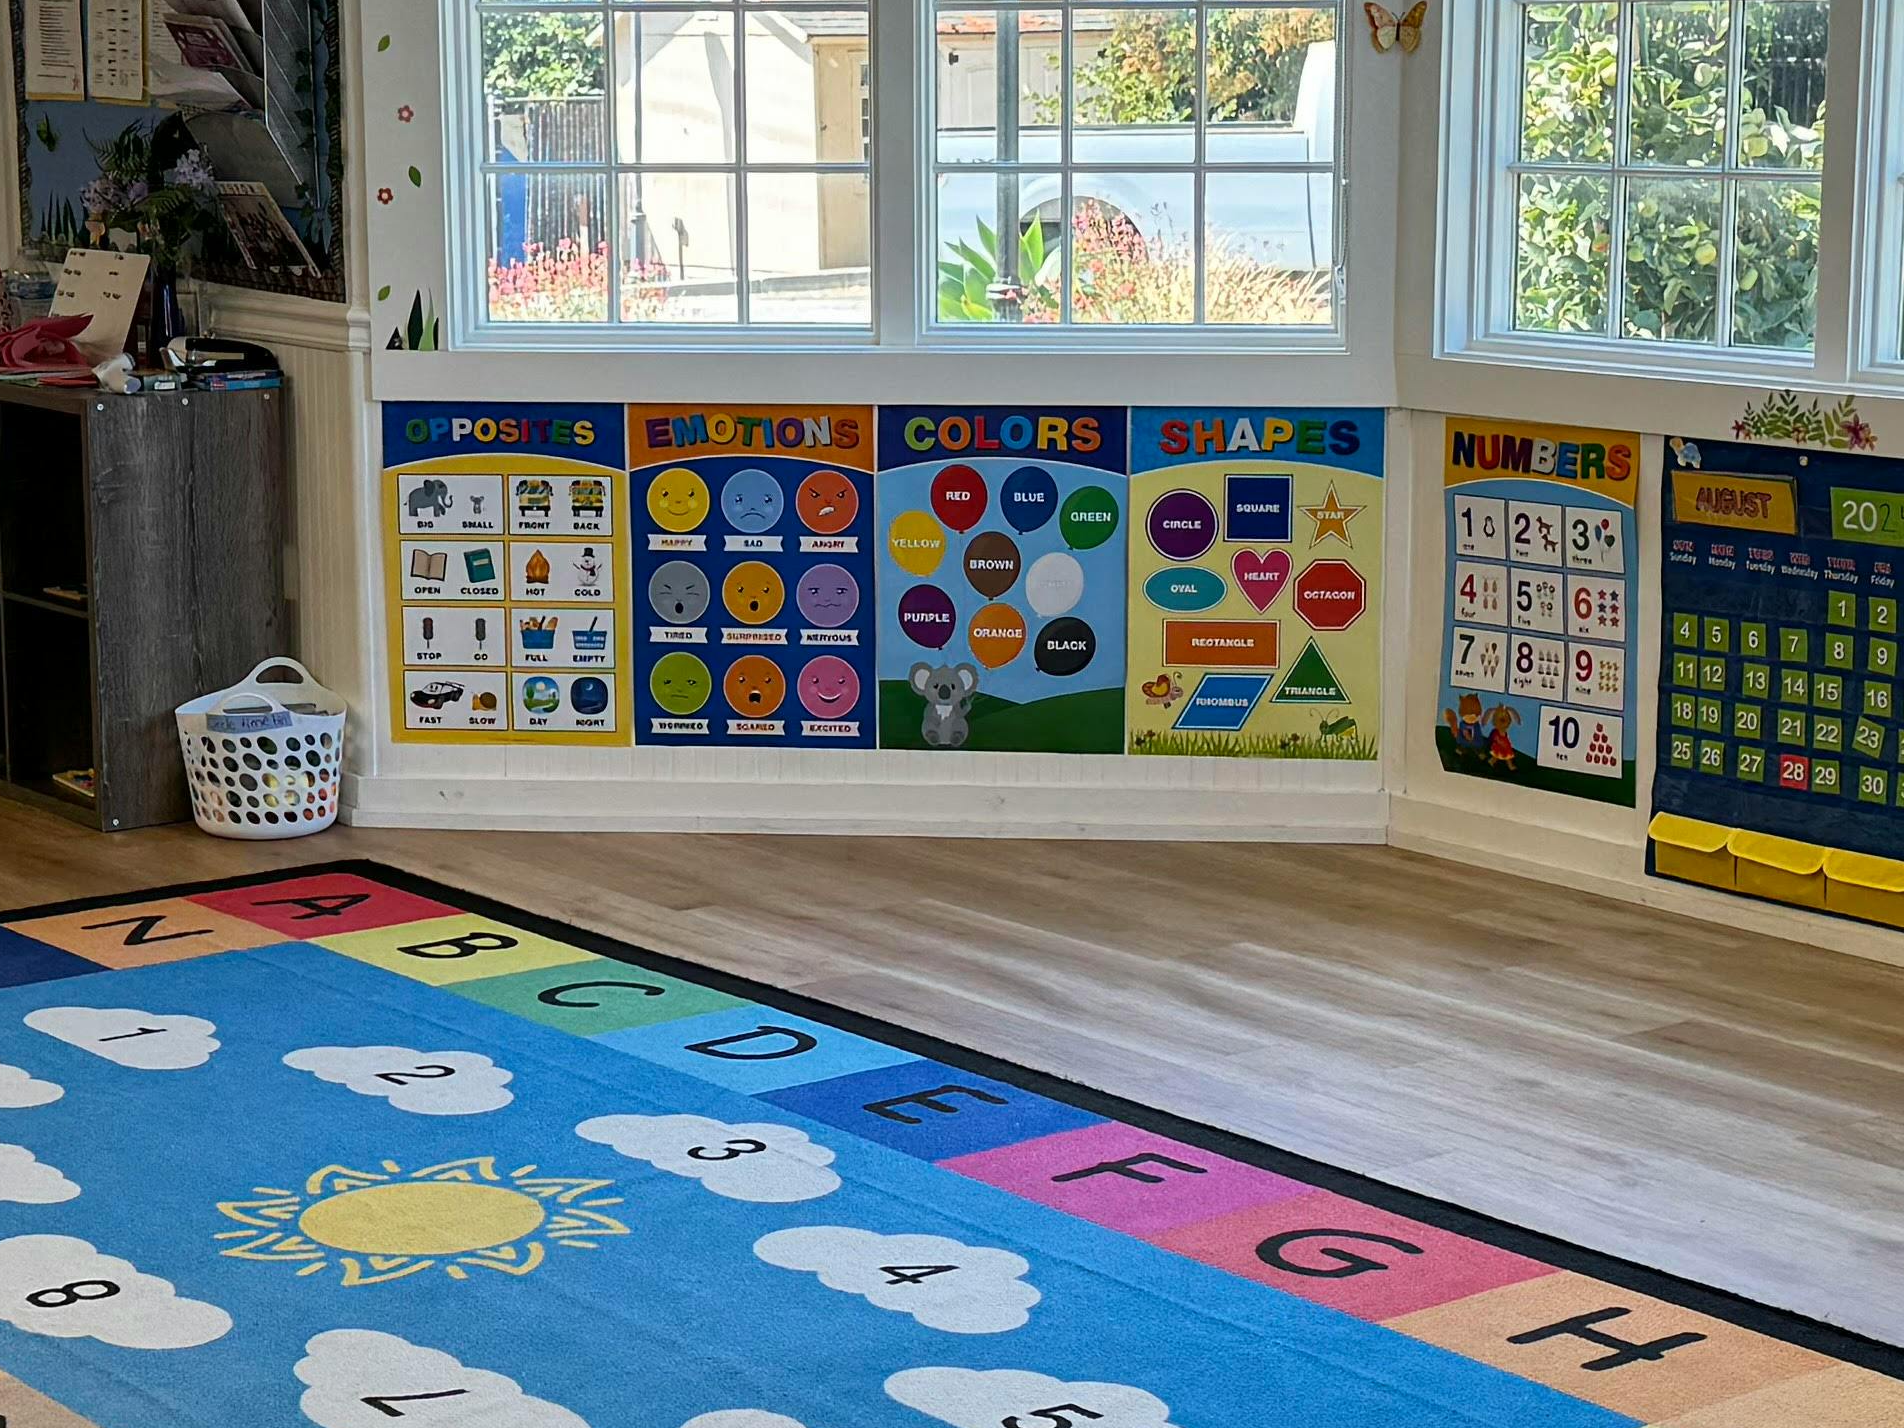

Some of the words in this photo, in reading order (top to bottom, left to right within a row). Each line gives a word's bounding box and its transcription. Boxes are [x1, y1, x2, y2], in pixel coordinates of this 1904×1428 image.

[406, 418, 595, 446] OPPOSITES
[645, 413, 860, 449] EMOTIONS
[904, 415, 1101, 451] COLORS
[1160, 415, 1361, 456] SHAPES
[1453, 431, 1632, 481] NUMBERS
[946, 491, 970, 502] RED
[1014, 491, 1044, 502] BLUE
[1695, 487, 1772, 519] AUGUST
[1071, 511, 1111, 522] GREEN
[1236, 504, 1280, 514] SQUARE
[1317, 510, 1345, 521] STAR
[1163, 520, 1201, 531] CIRCLE
[892, 537, 940, 549] YELLOW
[970, 559, 1014, 570] BROWN
[1670, 552, 1697, 566] Sunday
[1708, 555, 1736, 570] Monday
[1746, 559, 1776, 574] Tuesday
[1824, 570, 1858, 585] Thursday
[1871, 574, 1895, 589] Friday
[1244, 571, 1280, 582] HEART
[414, 587, 441, 595] OPEN
[526, 588, 545, 596] HOT
[574, 589, 601, 597] COLD
[1171, 584, 1197, 594] OVAL
[1304, 590, 1355, 601] OCTAGON
[904, 612, 950, 623] PURPLE
[974, 628, 1023, 639] ORANGE
[1047, 640, 1087, 651] BLACK
[1191, 638, 1254, 648] RECTANGLE
[1285, 687, 1336, 697] TRIANGLE
[1196, 696, 1248, 708] RHOMBUS
[420, 716, 442, 724] FAST
[469, 717, 496, 725] SLOW
[530, 718, 547, 726] DAY
[251, 891, 370, 921] A
[80, 913, 215, 947] Z
[396, 930, 520, 960] B
[537, 980, 667, 1008] C
[97, 1026, 168, 1043] 1
[684, 1024, 818, 1060] D
[375, 1064, 456, 1087] 2
[862, 1083, 1008, 1124] E
[686, 1138, 768, 1163] 3
[1050, 1151, 1208, 1184] F
[1255, 1227, 1426, 1279] G
[877, 1262, 961, 1286] 4
[25, 1278, 122, 1310] 8
[1505, 1306, 1708, 1373] H
[358, 1387, 471, 1418] 7
